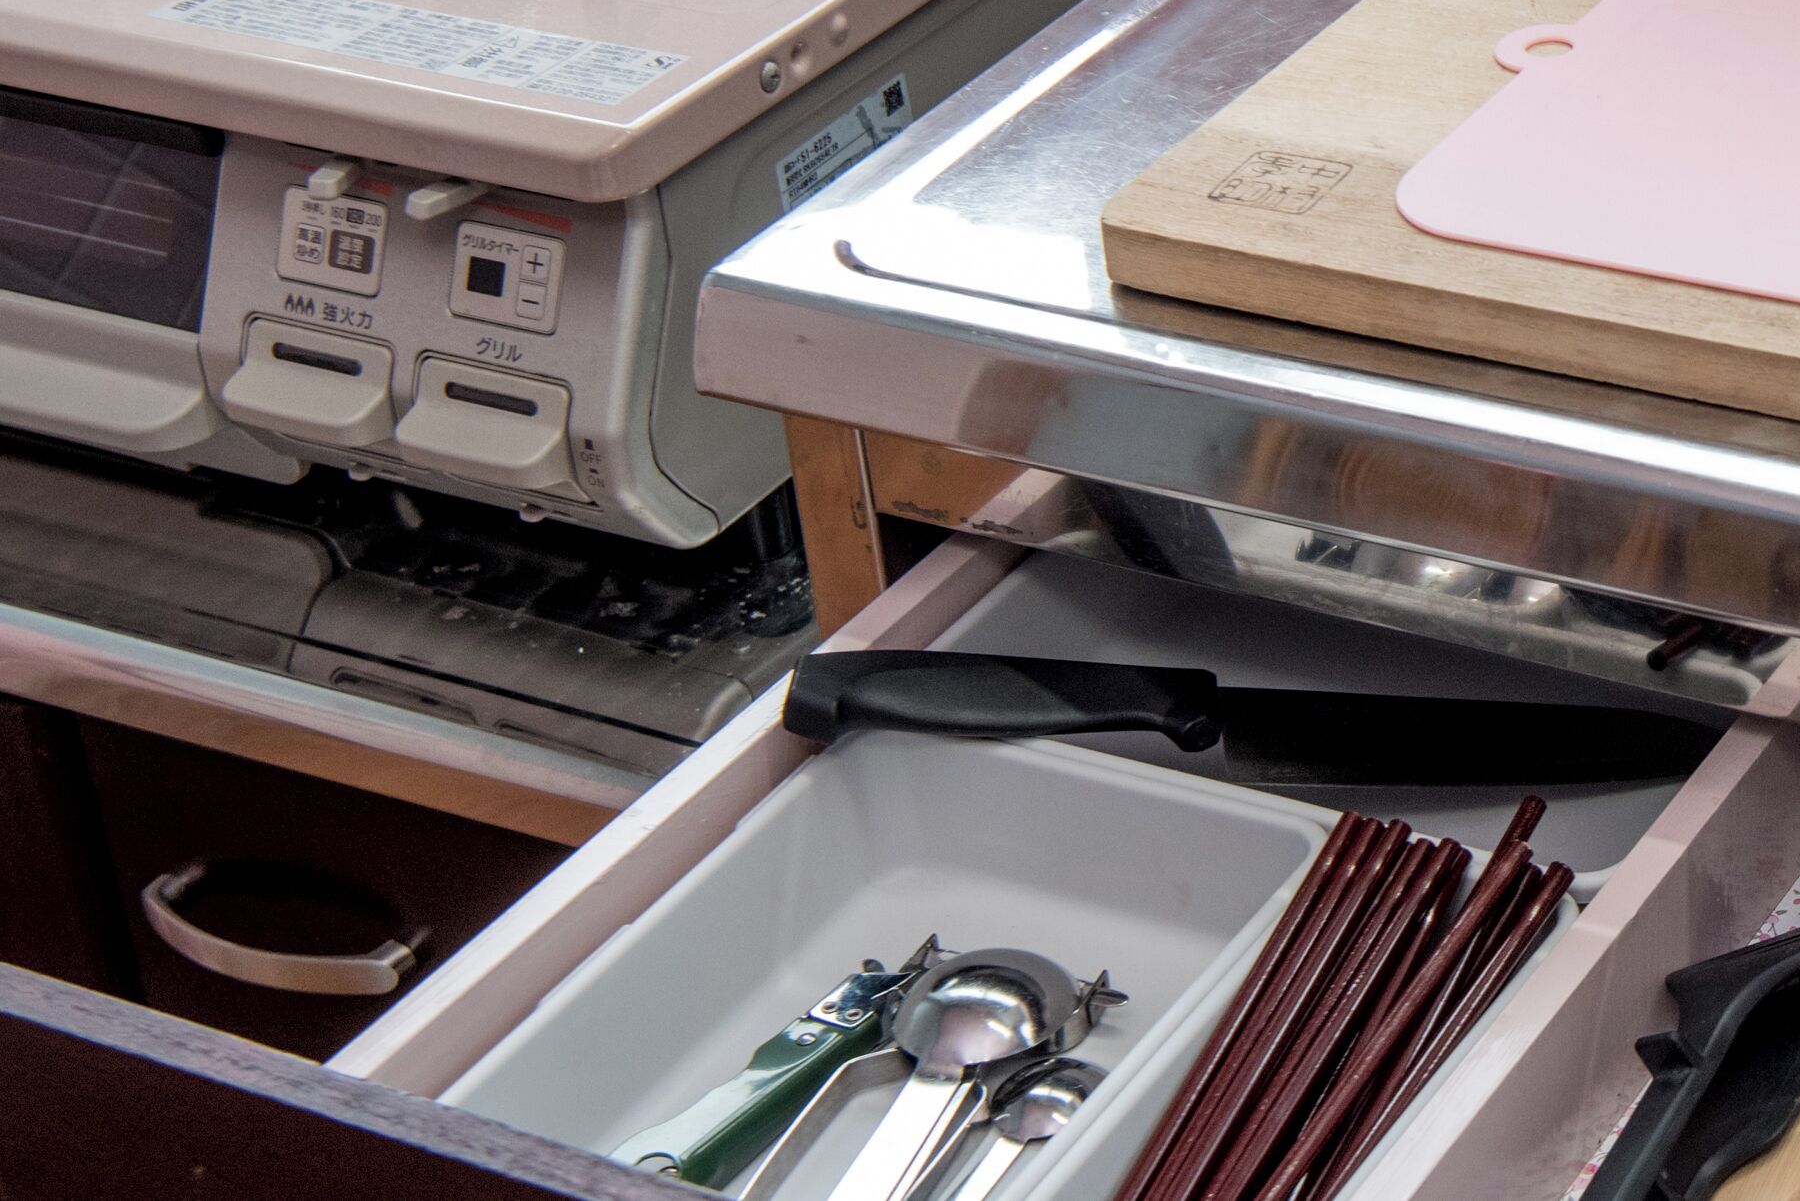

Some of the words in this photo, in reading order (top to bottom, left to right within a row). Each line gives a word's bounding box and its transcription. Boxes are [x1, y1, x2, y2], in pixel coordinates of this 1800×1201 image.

[462, 234, 520, 256] グリルタイマー
[322, 302, 373, 330] 強火力
[476, 337, 523, 362] グリル
[580, 451, 602, 464] OFF
